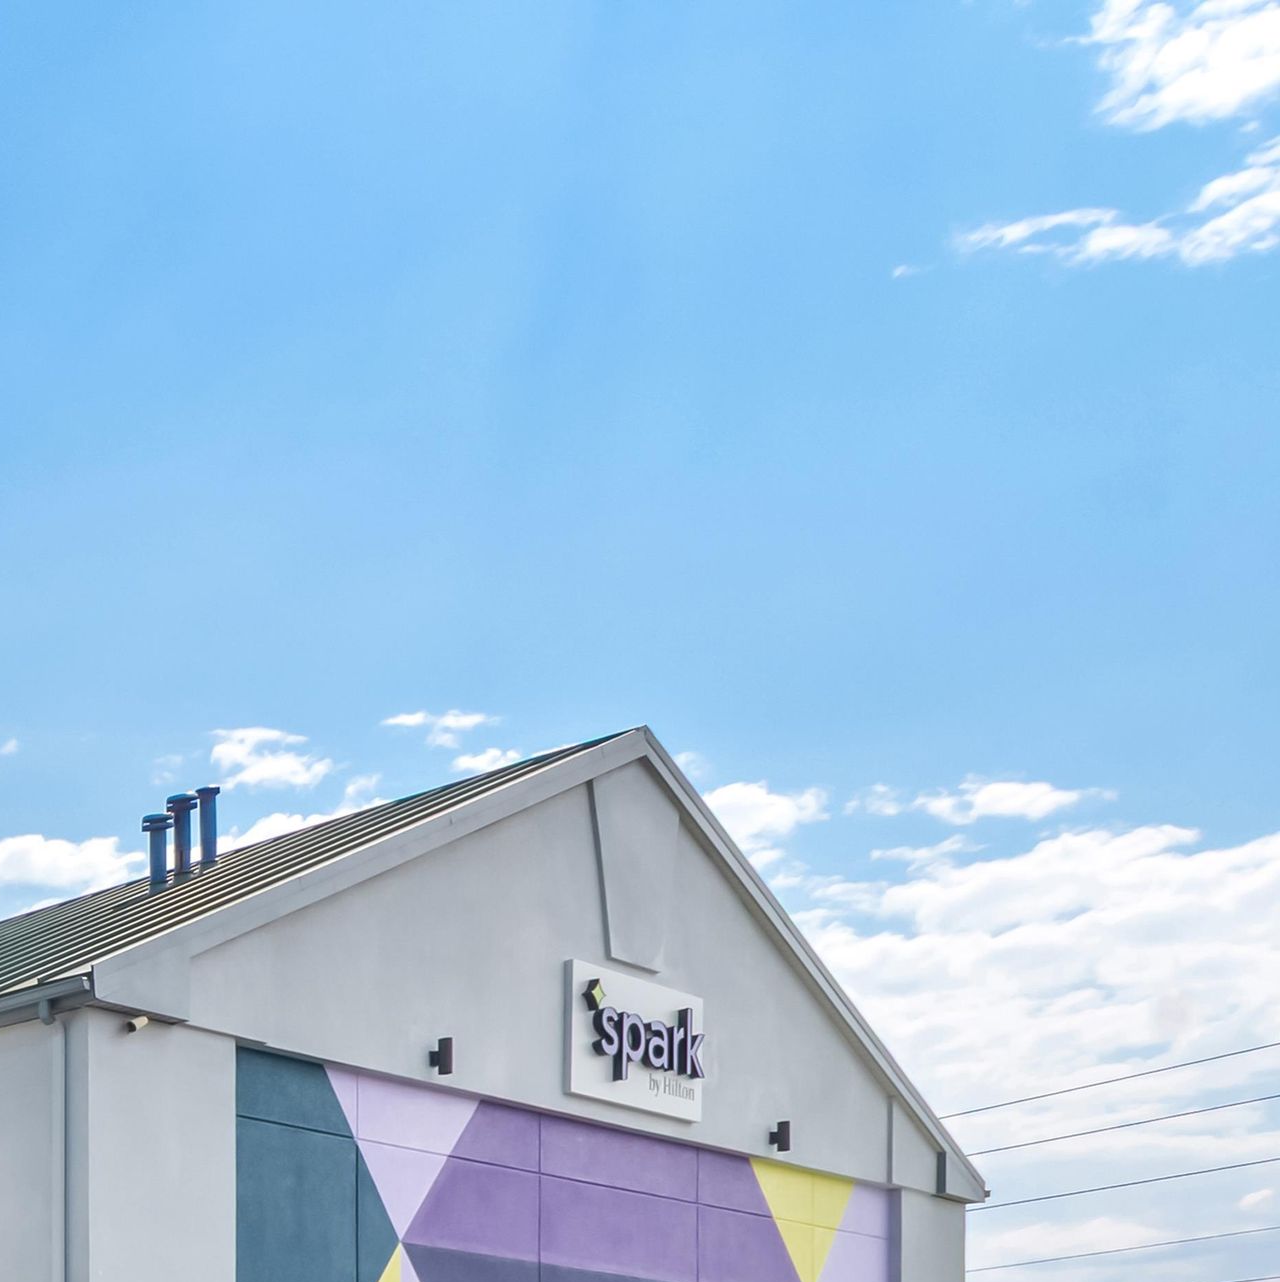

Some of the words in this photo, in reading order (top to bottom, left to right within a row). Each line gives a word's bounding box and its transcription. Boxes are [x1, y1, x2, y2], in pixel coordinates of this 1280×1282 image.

[592, 1006, 705, 1081] spark
[648, 1072, 659, 1097] by
[663, 1075, 695, 1101] Hilton
